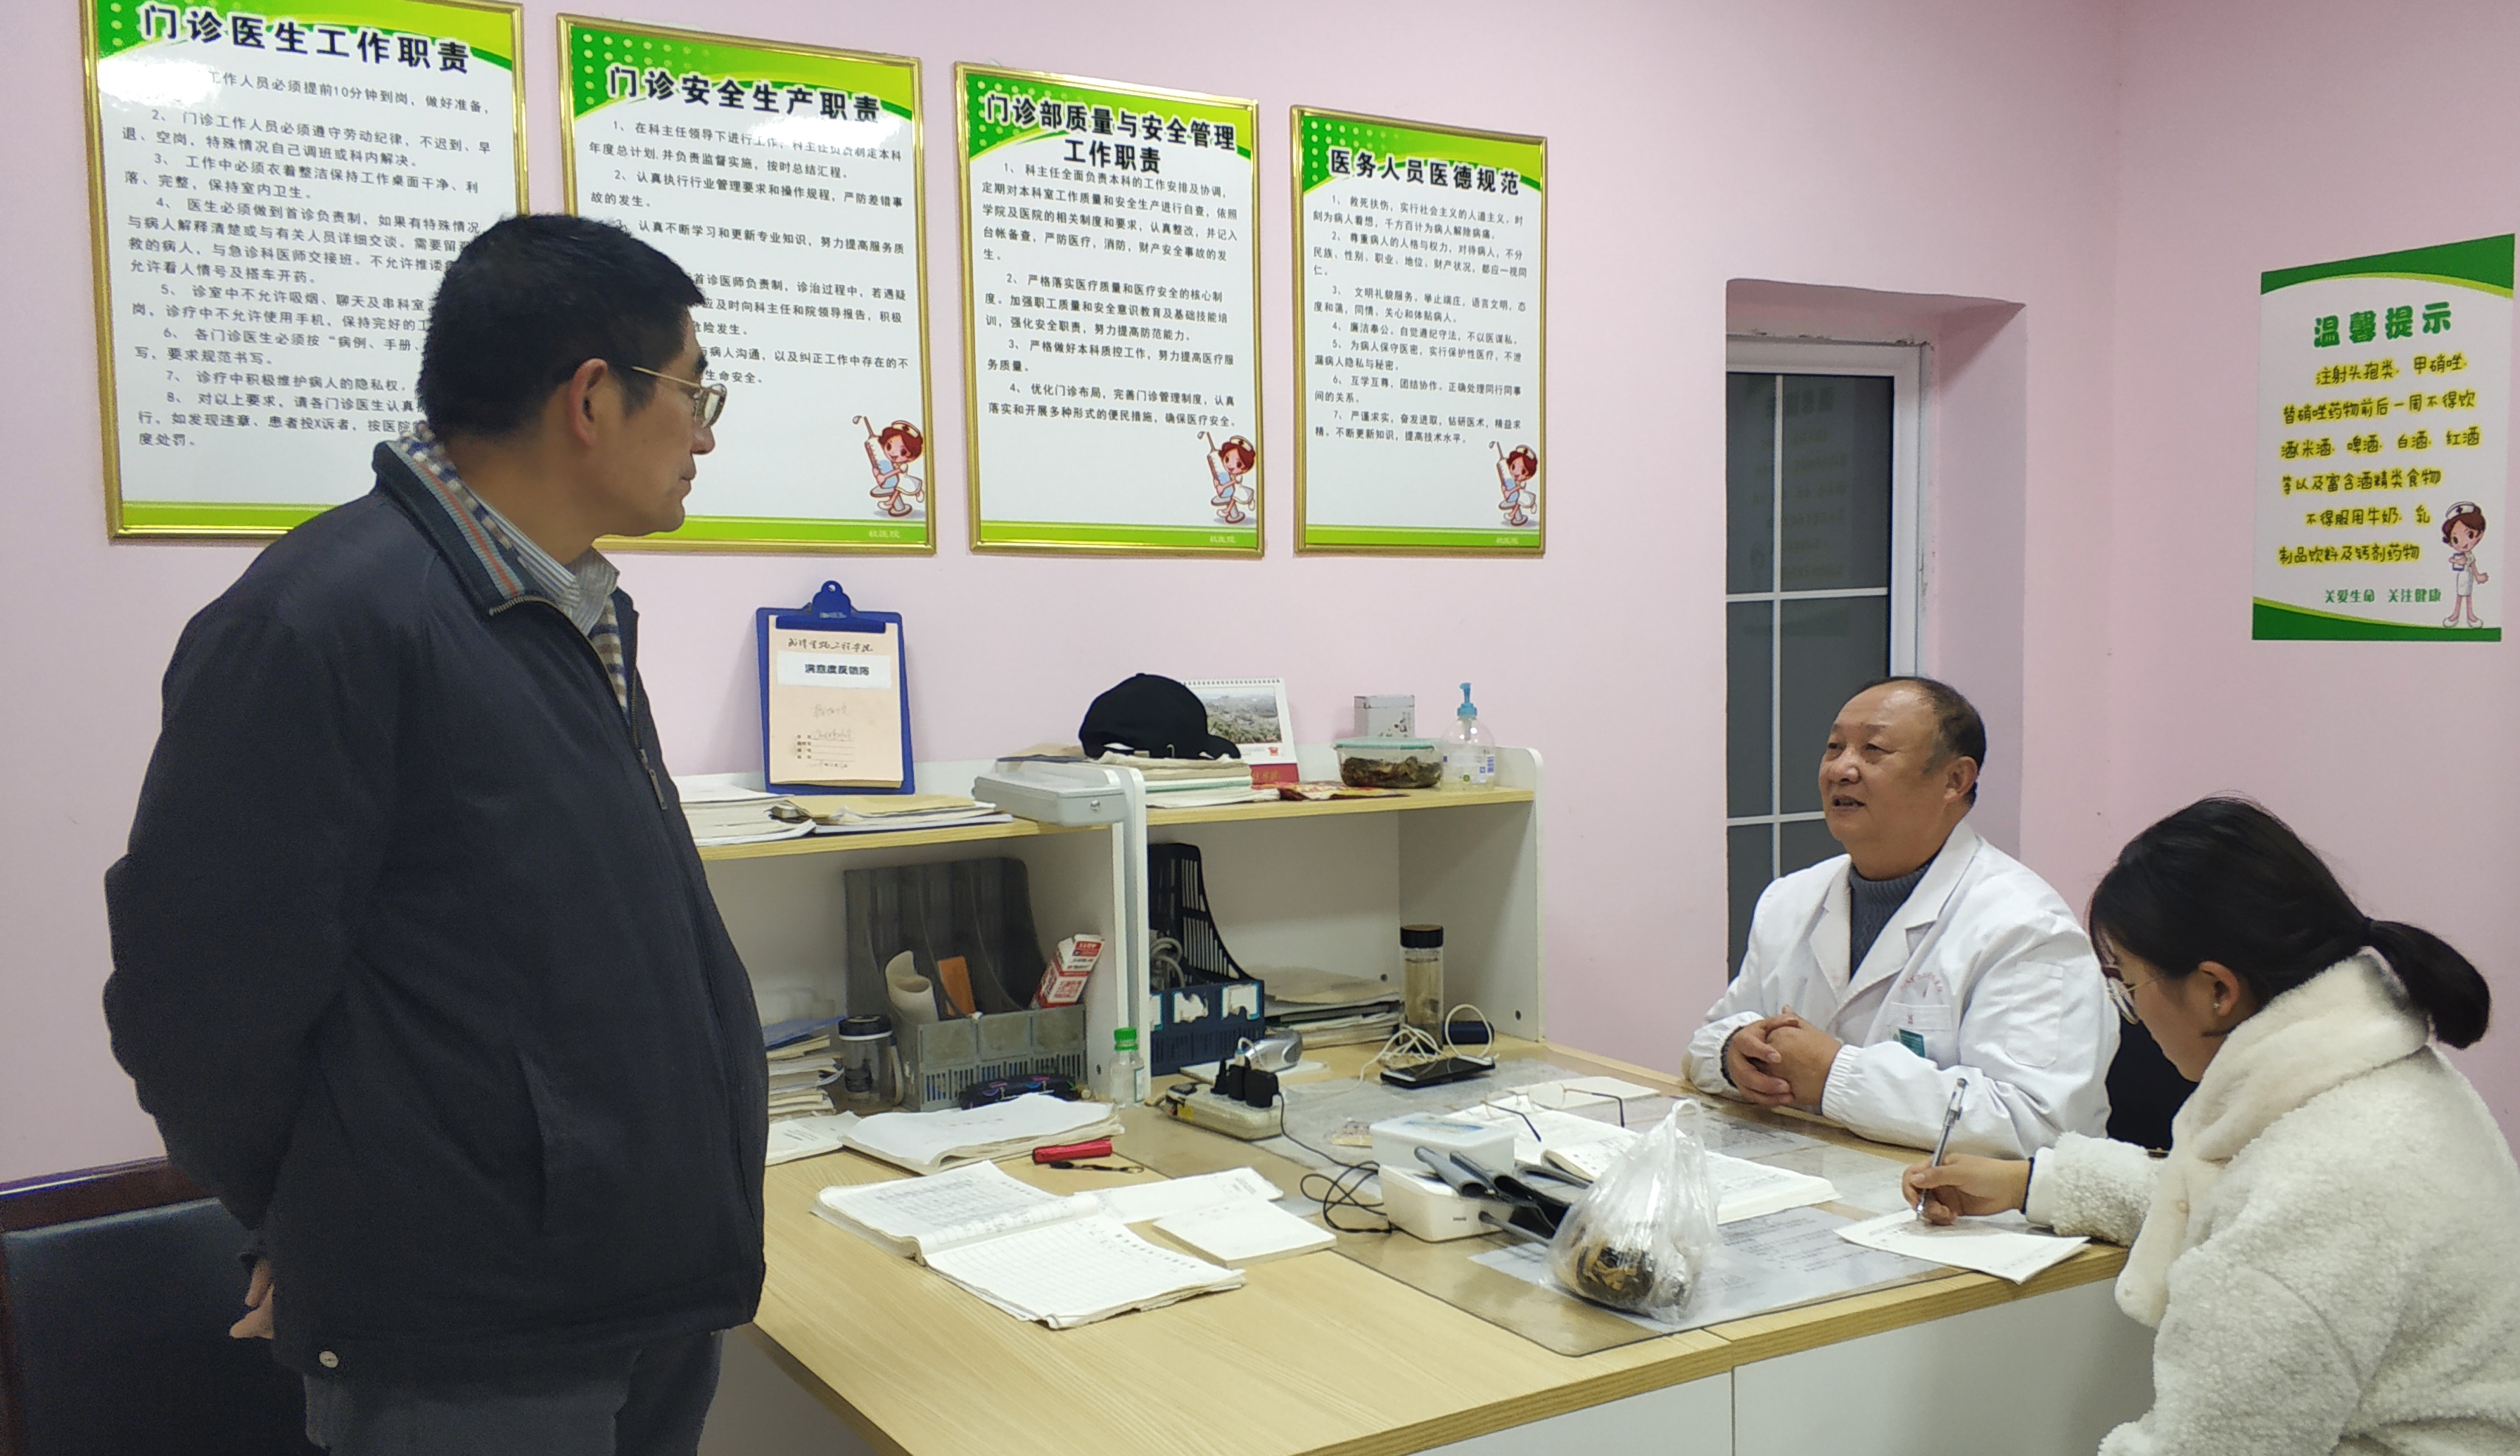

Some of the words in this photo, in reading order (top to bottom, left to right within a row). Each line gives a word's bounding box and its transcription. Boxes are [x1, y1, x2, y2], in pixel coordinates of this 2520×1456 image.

[141, 5, 469, 74] 门诊医生工作职责
[610, 66, 880, 124] 门诊安全生产职责
[987, 94, 1235, 151] 门诊部质量与安全管理
[1064, 139, 1160, 174] 工作职责
[1330, 149, 1520, 196] 医务人员医德规范
[591, 191, 651, 207] 故的发生。
[984, 248, 1000, 261] 生。
[1313, 264, 1328, 276] 仁。
[687, 272, 905, 301] 首诊医师负责制，诊治过程中，若遇疑
[695, 298, 902, 324] 应及时向科主任和院领导报告，积极
[2314, 301, 2451, 347] 温馨提示
[702, 369, 762, 383] 生命安全。
[988, 359, 1029, 372] 务质量。
[1315, 390, 1359, 403] 间的关系。
[2283, 389, 2476, 424] 替硝唑药物前后一周不得饮
[139, 433, 195, 446] 度处罚。
[2282, 468, 2441, 494] 等以及富含酒精类食物
[2279, 544, 2420, 564] 制品饮料及钙剂药物
[2325, 589, 2376, 604] 关爱生命
[2388, 588, 2441, 604] 关注健康
